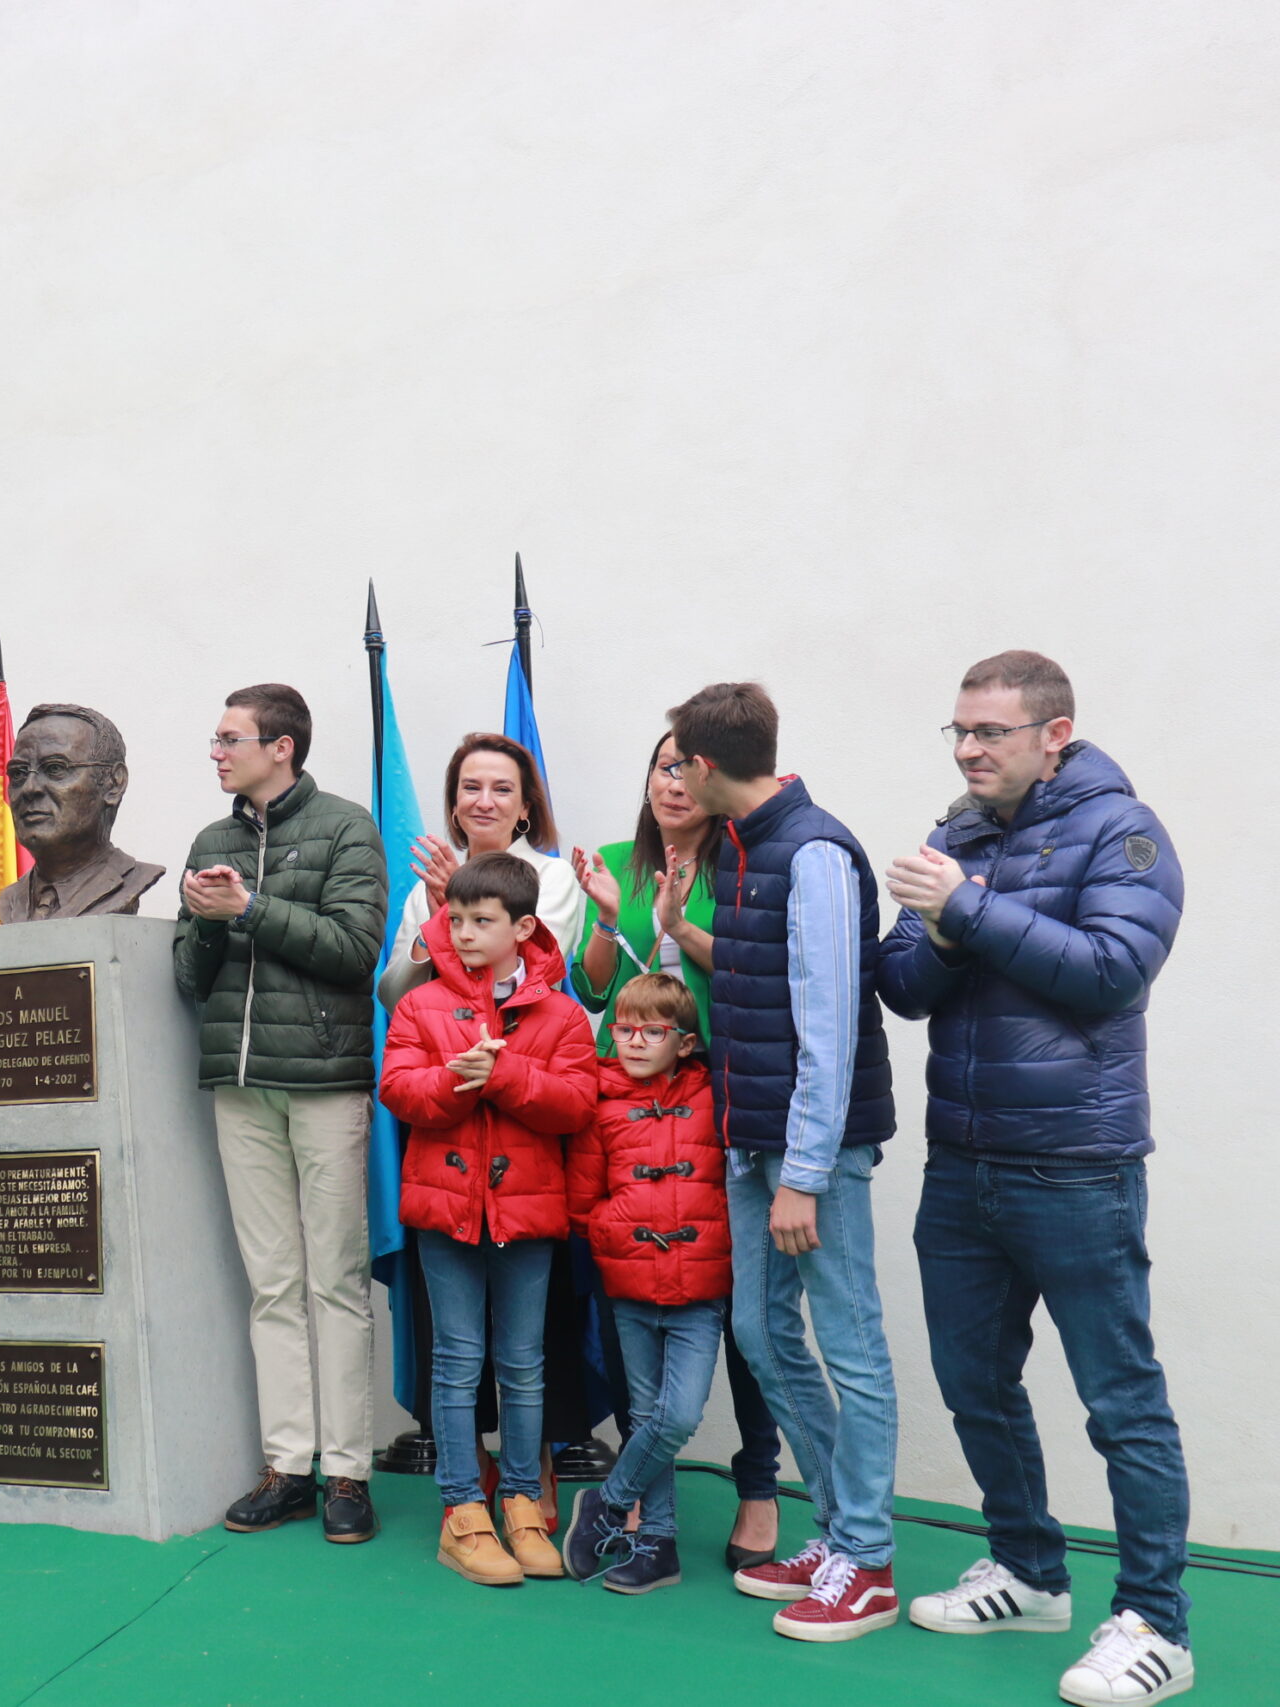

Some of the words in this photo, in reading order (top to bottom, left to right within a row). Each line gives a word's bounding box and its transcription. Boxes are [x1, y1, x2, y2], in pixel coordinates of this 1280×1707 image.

[15, 986, 23, 1000] A
[19, 1006, 70, 1024] MANUEL
[36, 1029, 81, 1046] PELAEZ
[42, 1056, 52, 1066] DE
[55, 1054, 90, 1065] CAFENTO
[35, 1074, 77, 1086] 1-4-2021
[7, 1182, 16, 1191] TE
[23, 1194, 32, 1203] EL
[33, 1193, 59, 1203] MEJOR
[5, 1206, 28, 1217] AMOR
[31, 1206, 38, 1216] A
[39, 1206, 49, 1216] LA
[14, 1218, 43, 1228] AFABLE
[46, 1218, 51, 1227] Y
[8, 1232, 18, 1241] EL
[5, 1244, 16, 1254] DE
[19, 1244, 29, 1254] LA
[33, 1243, 71, 1254] EMPRESA
[2, 1268, 18, 1278] POR
[22, 1268, 31, 1278] TU
[11, 1361, 44, 1372] AMIGOS
[51, 1362, 61, 1373] DE
[67, 1362, 78, 1373] LA
[13, 1380, 57, 1394] ESPAÑOLA
[60, 1385, 75, 1395] DEL
[21, 1404, 98, 1417] AGRADECIMIENTO
[19, 1425, 30, 1436] TU
[46, 1447, 56, 1458] AL
